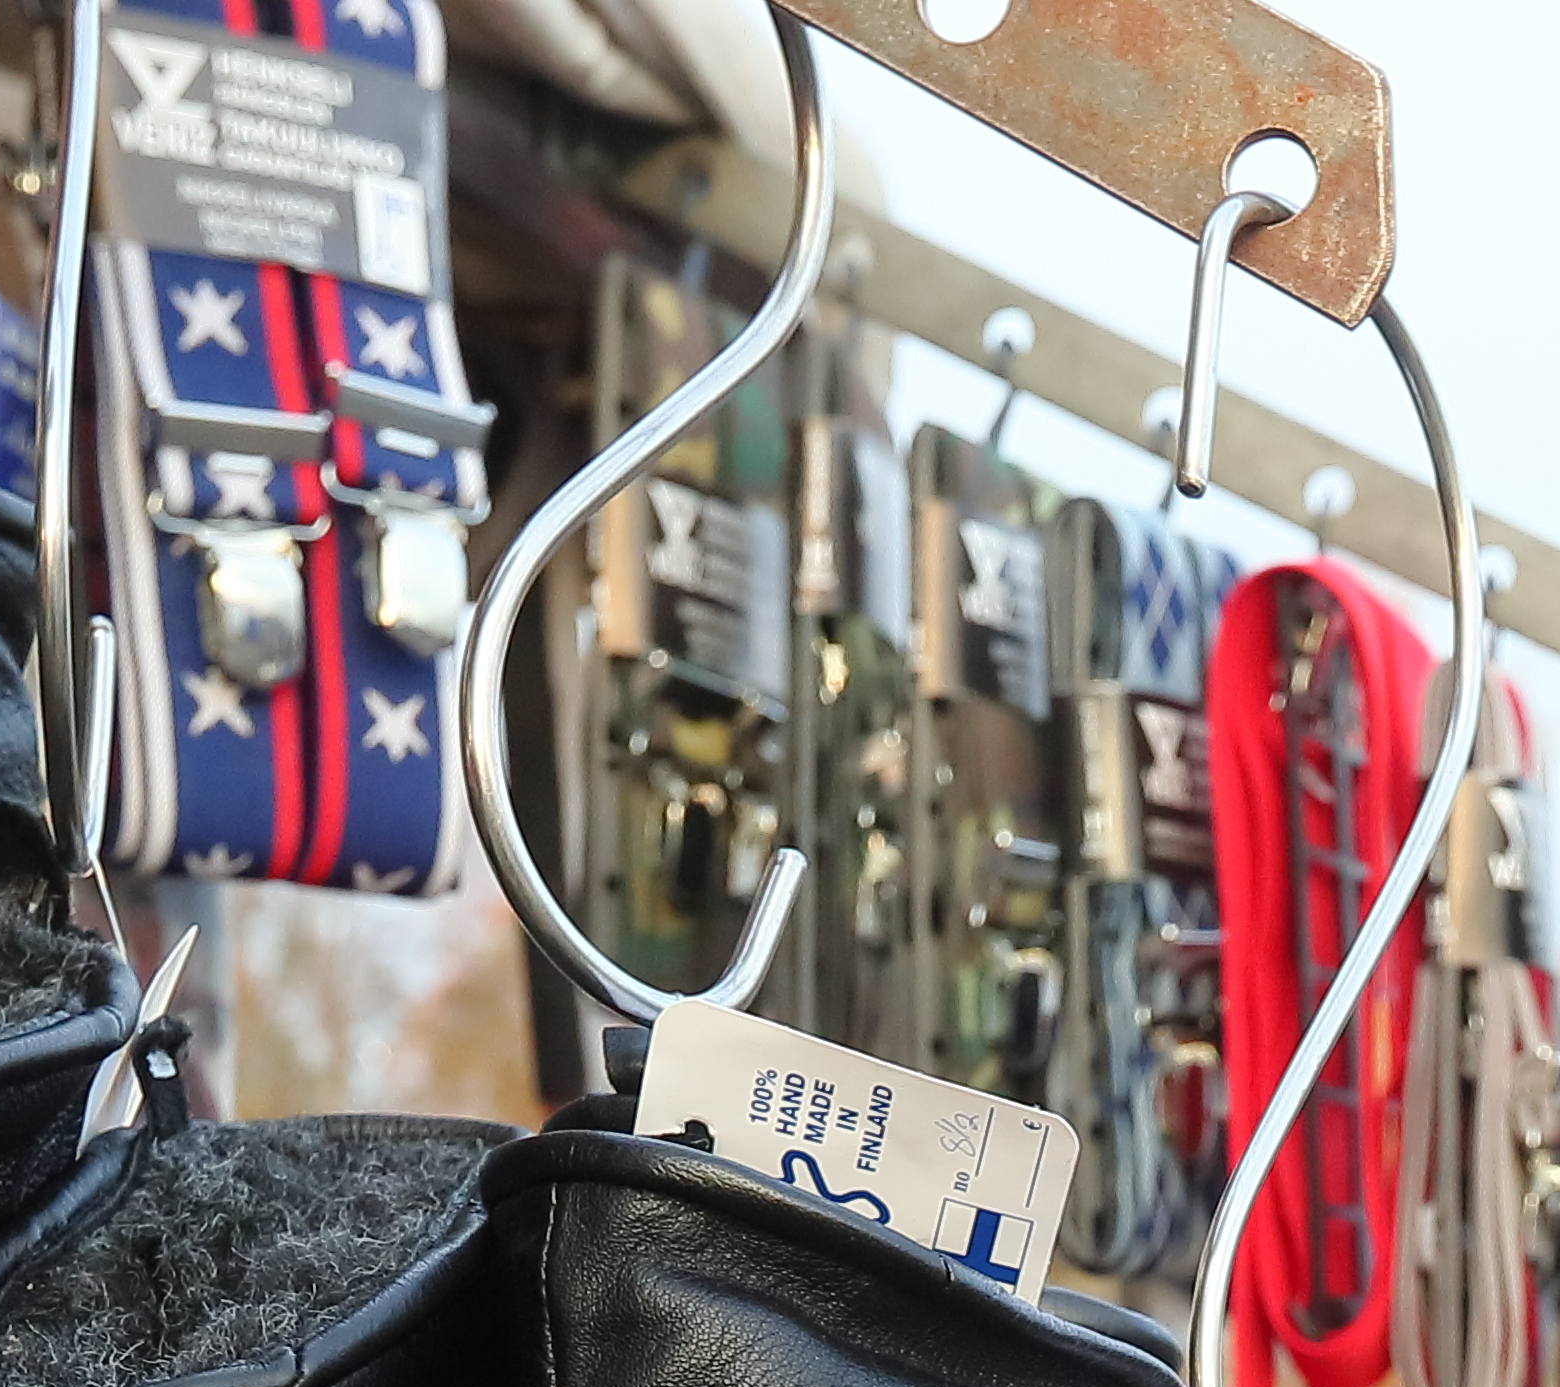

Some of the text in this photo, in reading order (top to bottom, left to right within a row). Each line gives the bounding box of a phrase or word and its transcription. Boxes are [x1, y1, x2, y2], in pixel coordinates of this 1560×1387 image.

[748, 1069, 778, 1123] 100%
[774, 1073, 806, 1136] HAND
[803, 1079, 836, 1144] MADE
[835, 1106, 860, 1131] IN
[856, 1085, 893, 1172] FINLAND
